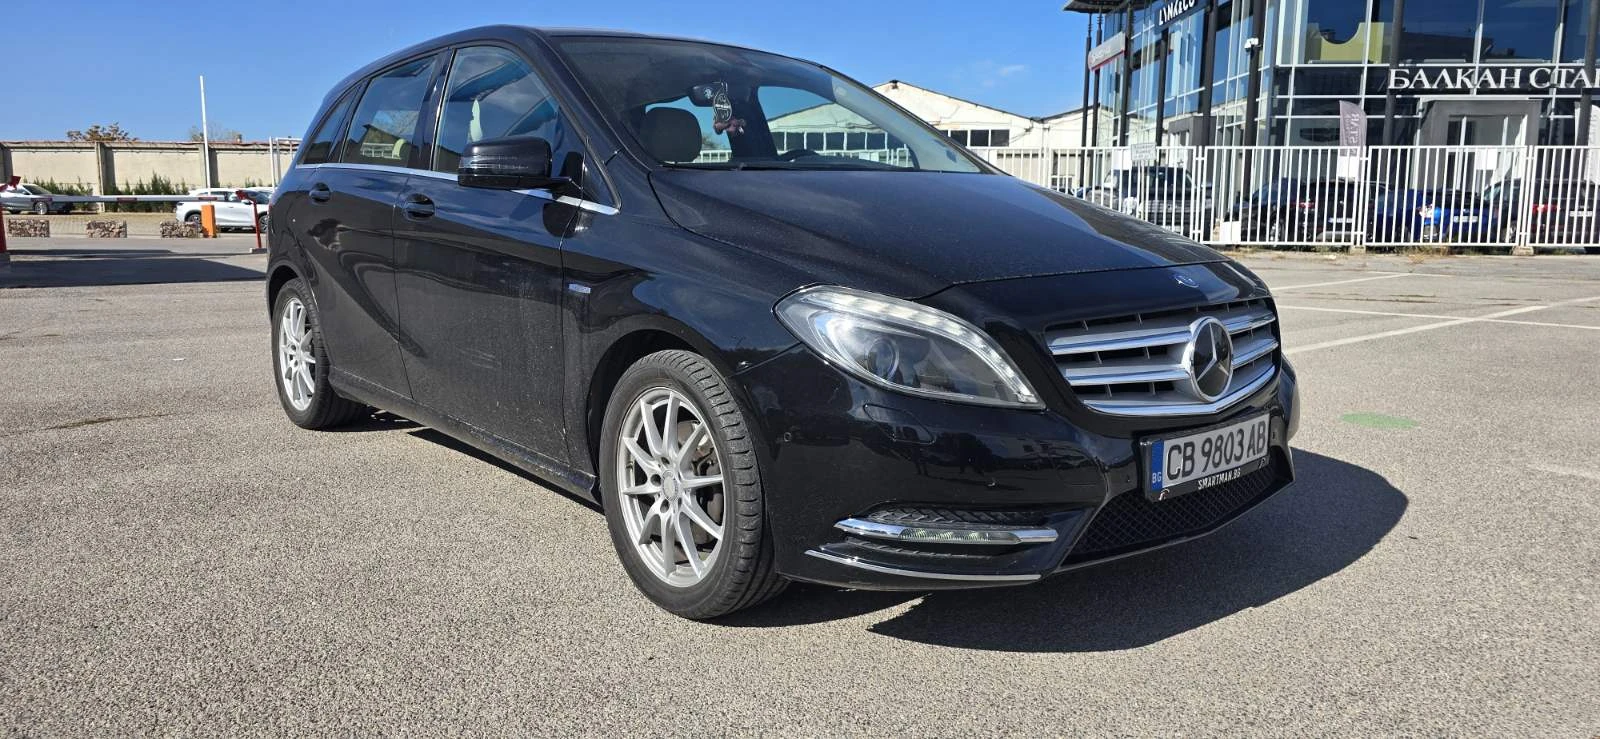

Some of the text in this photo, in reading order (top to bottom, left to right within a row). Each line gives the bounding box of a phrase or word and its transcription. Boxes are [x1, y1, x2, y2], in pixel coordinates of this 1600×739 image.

[1388, 68, 1521, 88] БАЛКАН
[1166, 420, 1266, 480] CB 9803 AB
[1152, 471, 1162, 484] BG
[1197, 467, 1241, 490] SMARTMAN.BG
